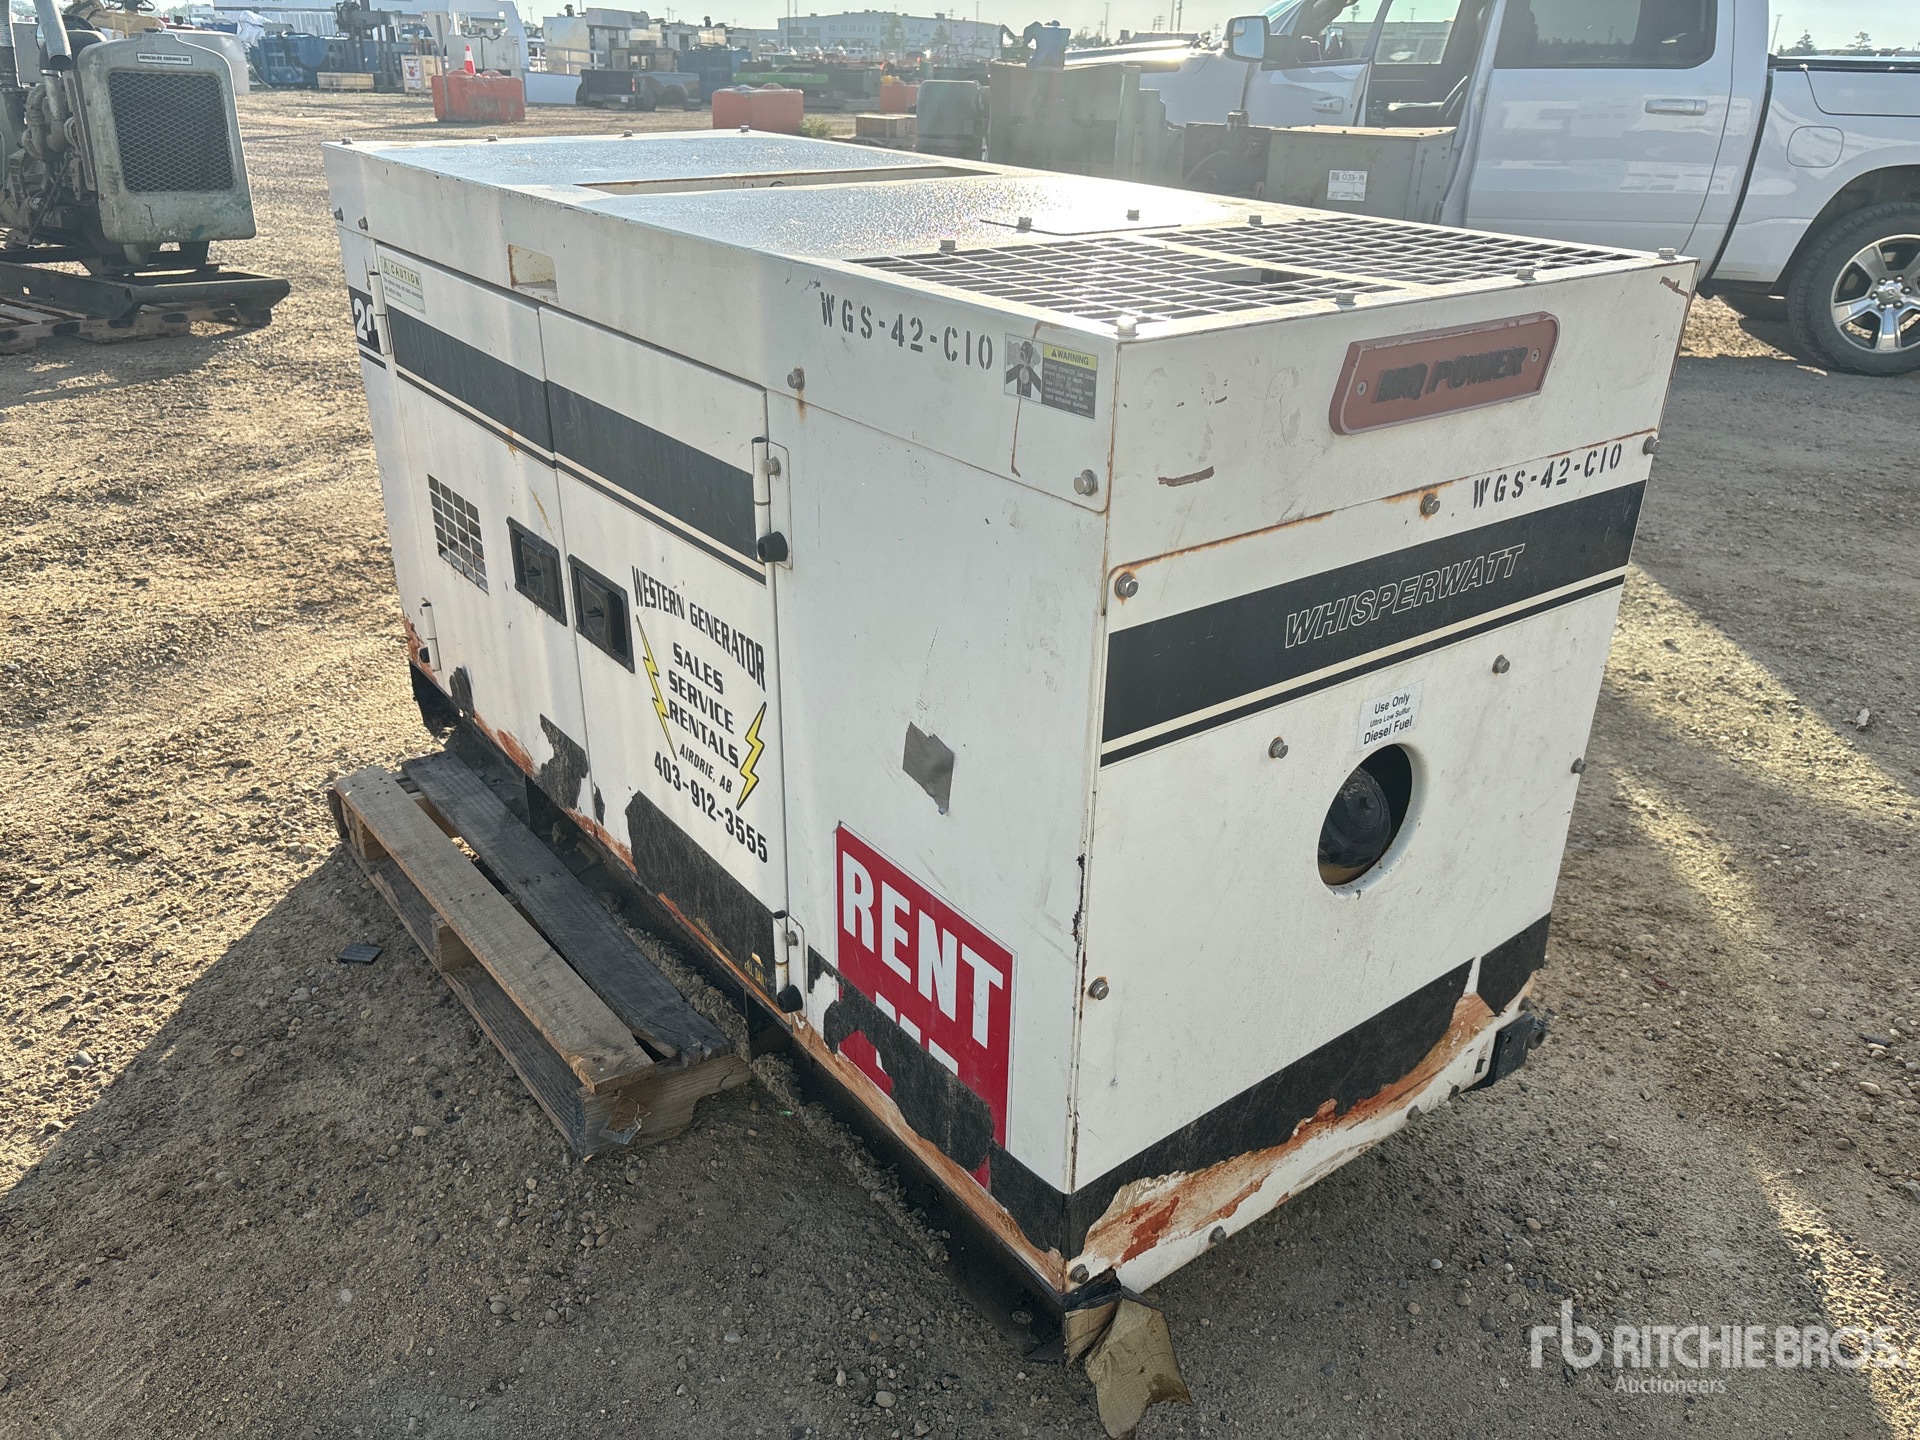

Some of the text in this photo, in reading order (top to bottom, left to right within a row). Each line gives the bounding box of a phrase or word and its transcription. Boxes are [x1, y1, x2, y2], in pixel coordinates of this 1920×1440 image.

[390, 264, 420, 286] CAUTION
[1057, 350, 1089, 365] WARNING
[1375, 346, 1529, 403] MQ POWER
[1285, 543, 1525, 649] WHISPERWATT
[632, 565, 766, 693] WESTERN GENERATOR
[673, 642, 723, 695] SALES
[668, 669, 734, 735] SERVICE
[1364, 715, 1413, 744] Diesel Fuel
[1374, 693, 1410, 714] Use Only
[1383, 714, 1394, 722] Low
[668, 698, 739, 769] RENTALS
[679, 743, 733, 793] AIRDRIE, AB
[654, 751, 768, 863] 403-912-3555
[842, 850, 1004, 1050] RENT
